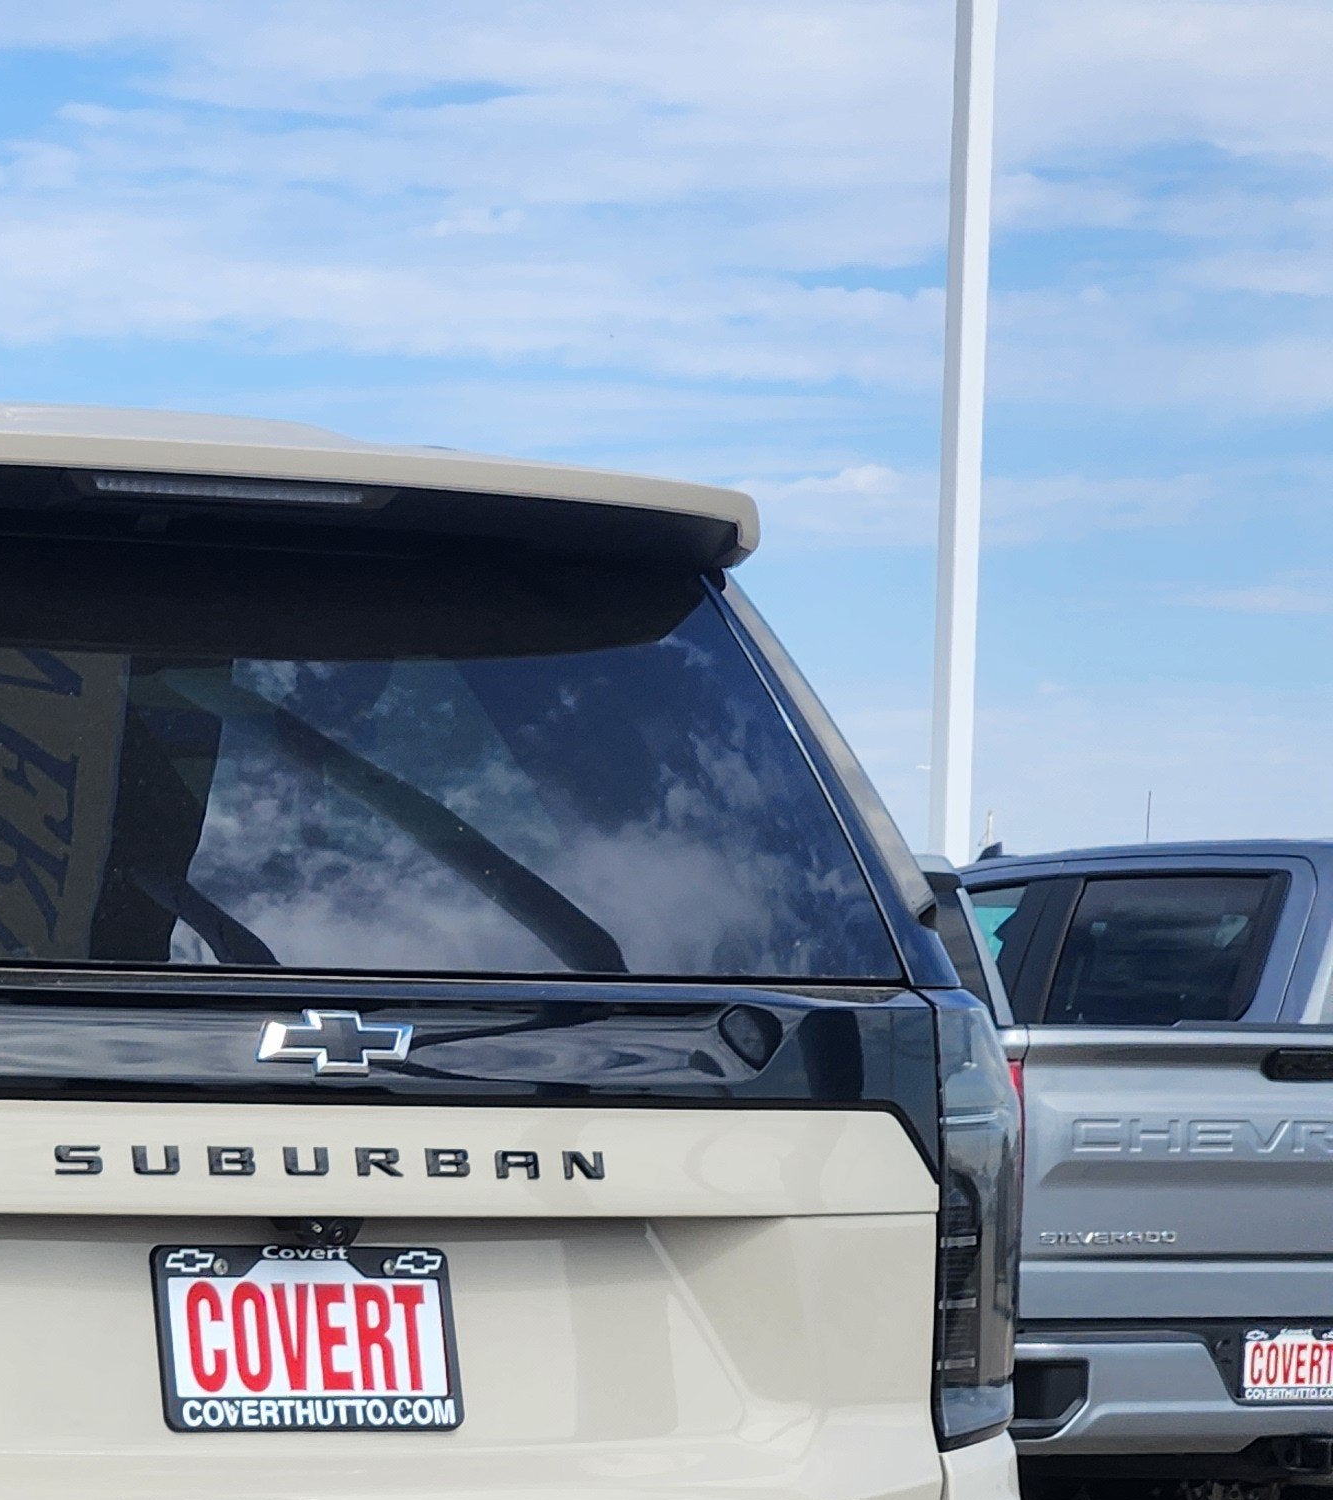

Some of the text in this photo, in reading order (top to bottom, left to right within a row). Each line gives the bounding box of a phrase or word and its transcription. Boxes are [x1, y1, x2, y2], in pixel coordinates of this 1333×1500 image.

[53, 1144, 606, 1181] SUBURBAN
[261, 1245, 349, 1261] Covert
[1038, 1231, 1177, 1245] SILVERADO
[186, 1280, 425, 1393] COVERT
[183, 1398, 457, 1428] COVERTHUTTO.COM
